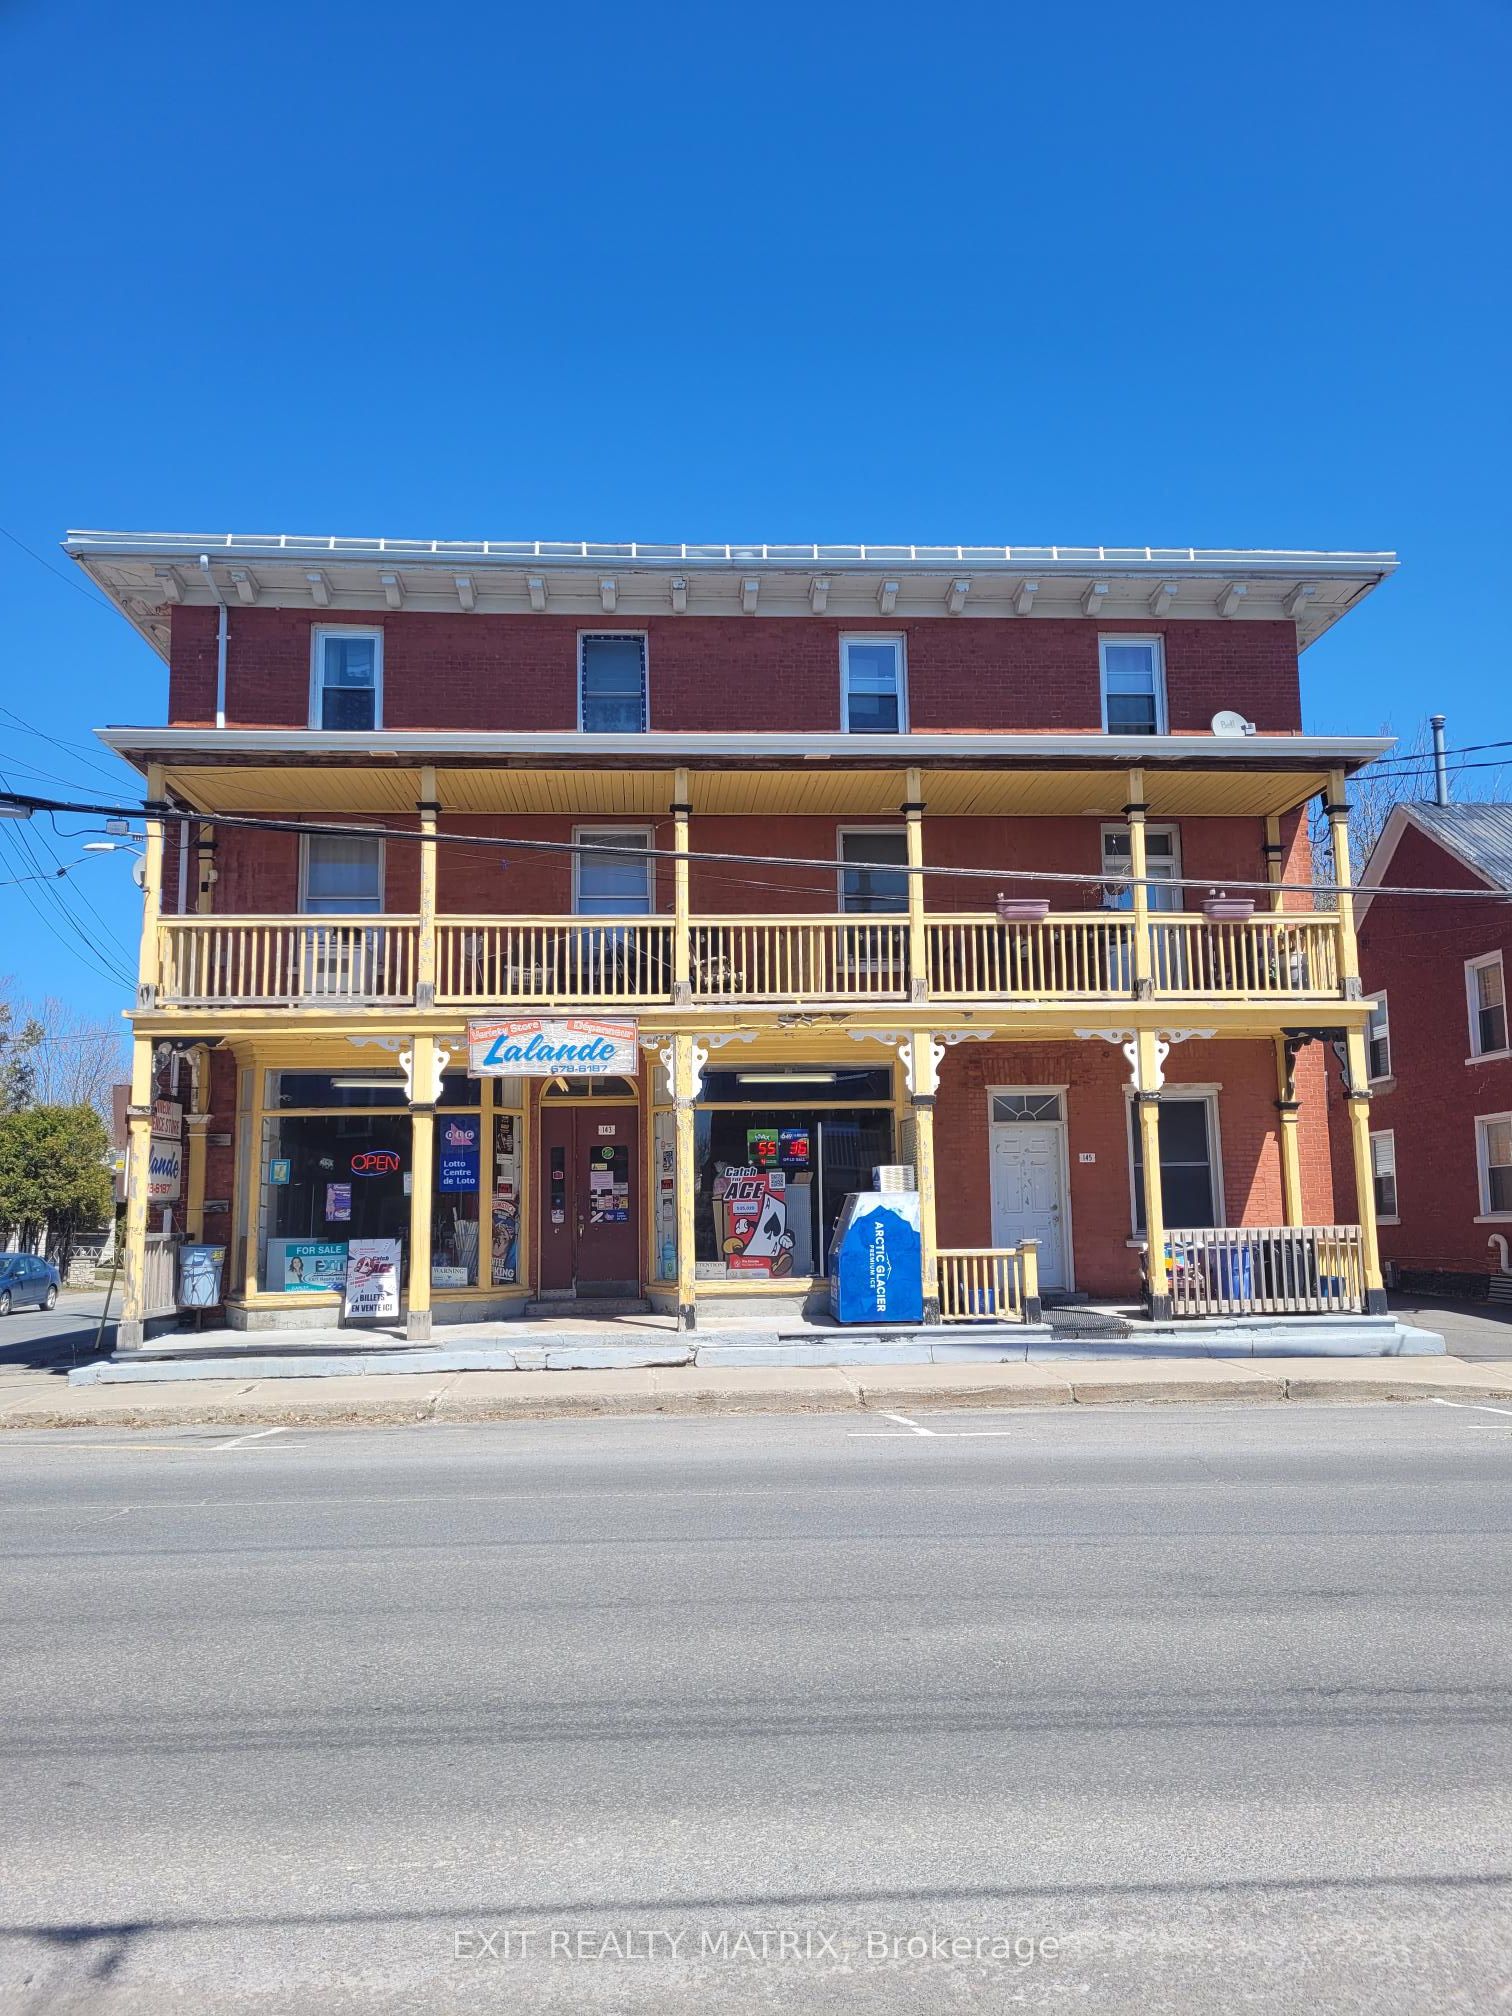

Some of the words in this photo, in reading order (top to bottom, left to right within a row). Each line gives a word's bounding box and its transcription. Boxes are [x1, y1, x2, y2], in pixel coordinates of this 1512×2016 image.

[509, 1021, 539, 1033] Store
[483, 1033, 616, 1066] Lalande
[550, 1064, 608, 1073] 678-6187
[351, 1154, 399, 1171] OPEN
[443, 1160, 466, 1168] Lotto
[443, 1168, 472, 1176] Centre
[725, 1167, 757, 1177] Catch
[443, 1177, 454, 1185] de
[456, 1177, 476, 1185] Loto
[724, 1182, 765, 1200] ACE
[874, 1221, 885, 1262] ARCTIC
[296, 1246, 316, 1255] FOR
[318, 1245, 342, 1254] SALE
[876, 1265, 887, 1312] GLACIER
[360, 1293, 385, 1302] BILLETS
[351, 1304, 360, 1313] EN
[361, 1304, 382, 1313] VENTE
[382, 1303, 393, 1312] ICI
